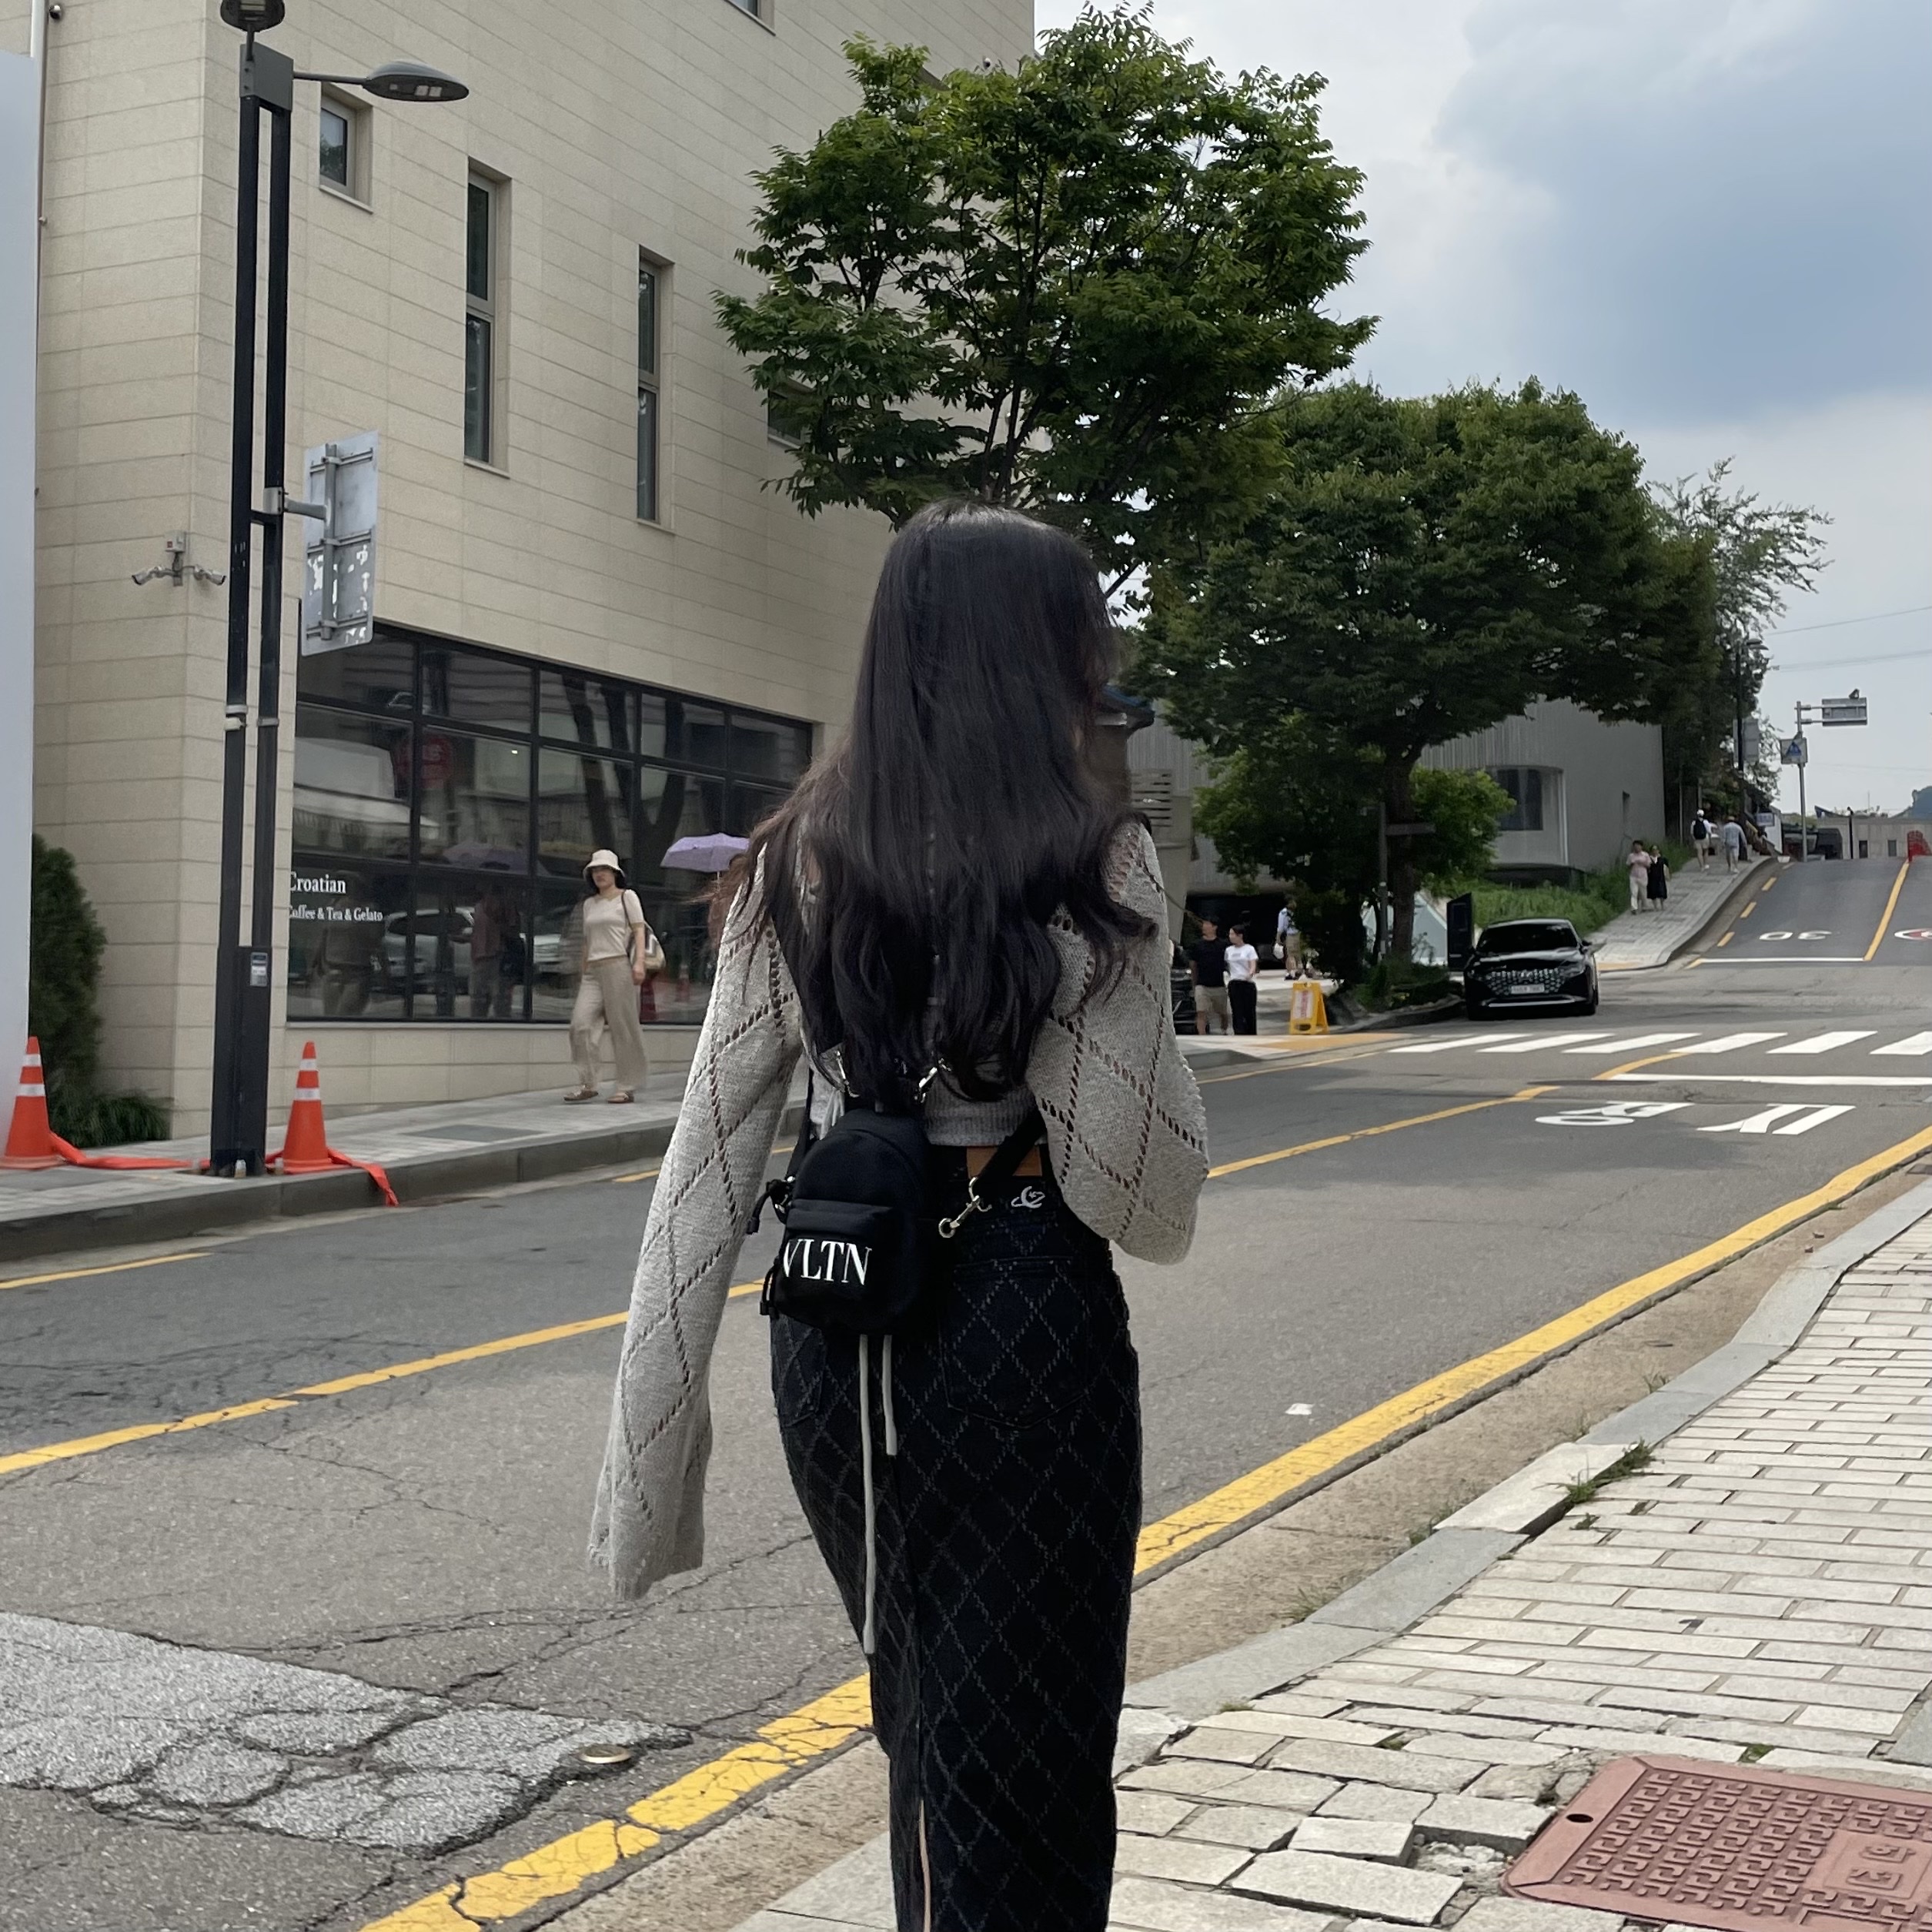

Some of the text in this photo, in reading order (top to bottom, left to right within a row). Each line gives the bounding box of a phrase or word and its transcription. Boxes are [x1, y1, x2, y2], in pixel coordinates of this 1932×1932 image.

[290, 871, 346, 894] Croatian
[317, 907, 325, 921] &
[326, 906, 343, 921] Tea
[344, 908, 352, 921] &
[353, 906, 383, 922] Gelato
[1534, 1101, 1857, 1135] 정지
[783, 1238, 873, 1286] VLTN
